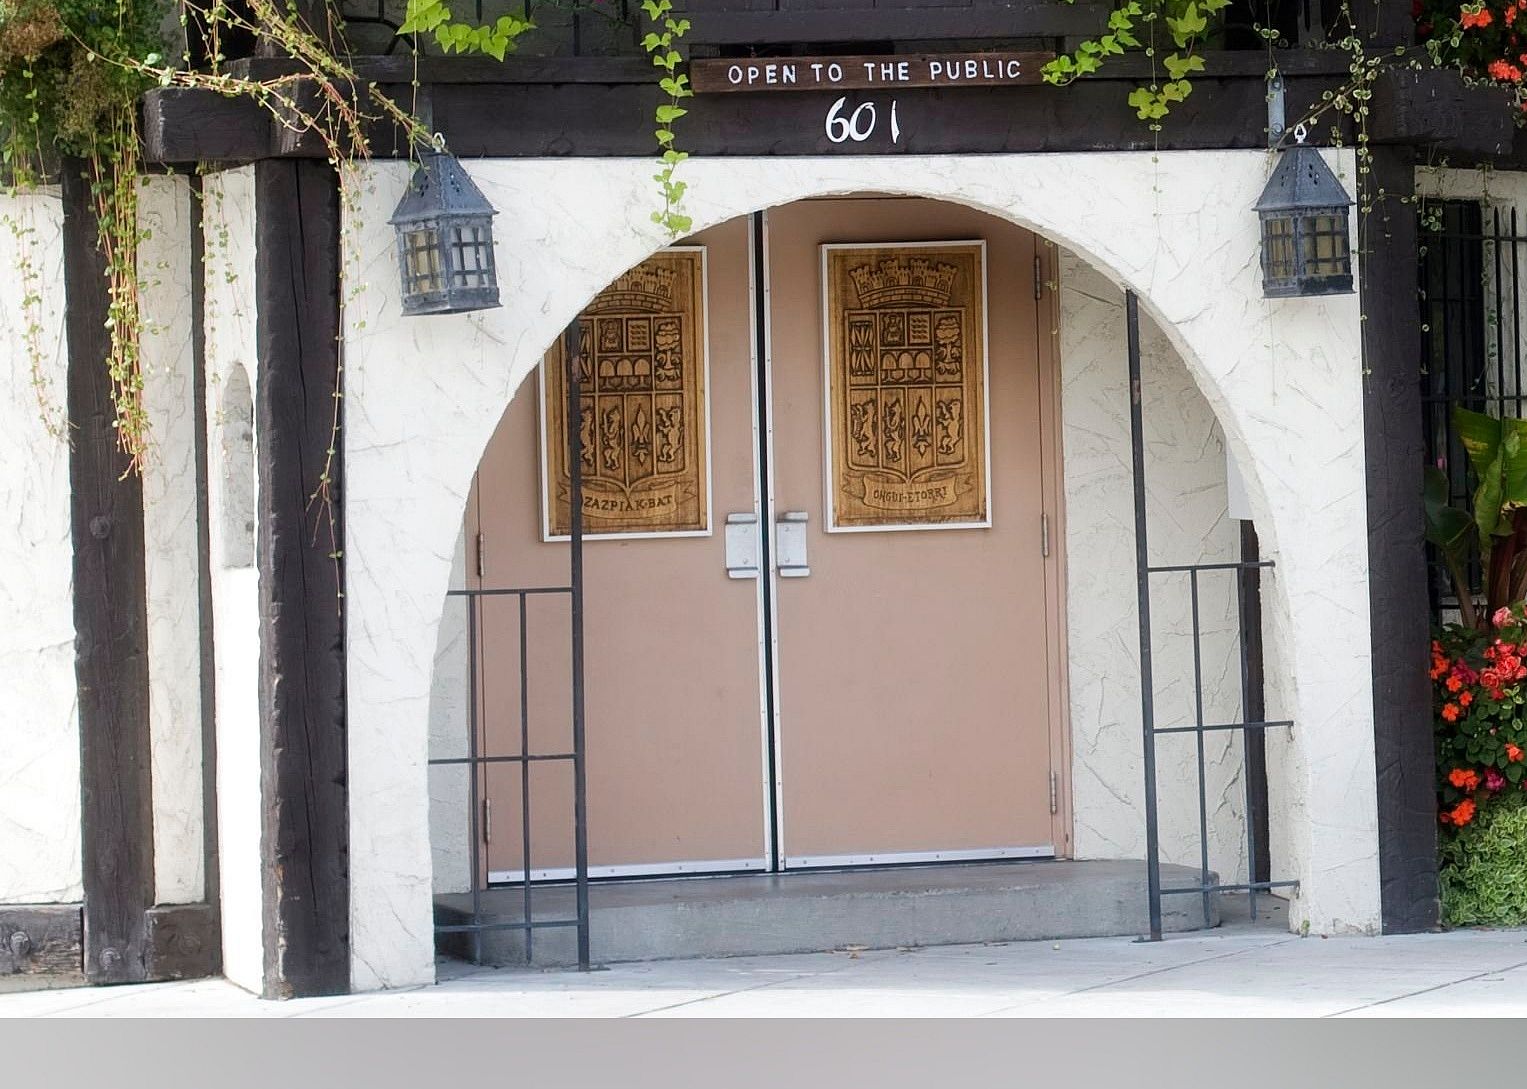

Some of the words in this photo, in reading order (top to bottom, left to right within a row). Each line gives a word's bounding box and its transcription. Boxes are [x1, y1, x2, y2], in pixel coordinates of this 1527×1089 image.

[727, 64, 797, 85] OPEN
[810, 63, 843, 83] TO
[863, 62, 910, 82] THE
[929, 59, 1022, 81] PUBLIC
[825, 96, 901, 145] 601
